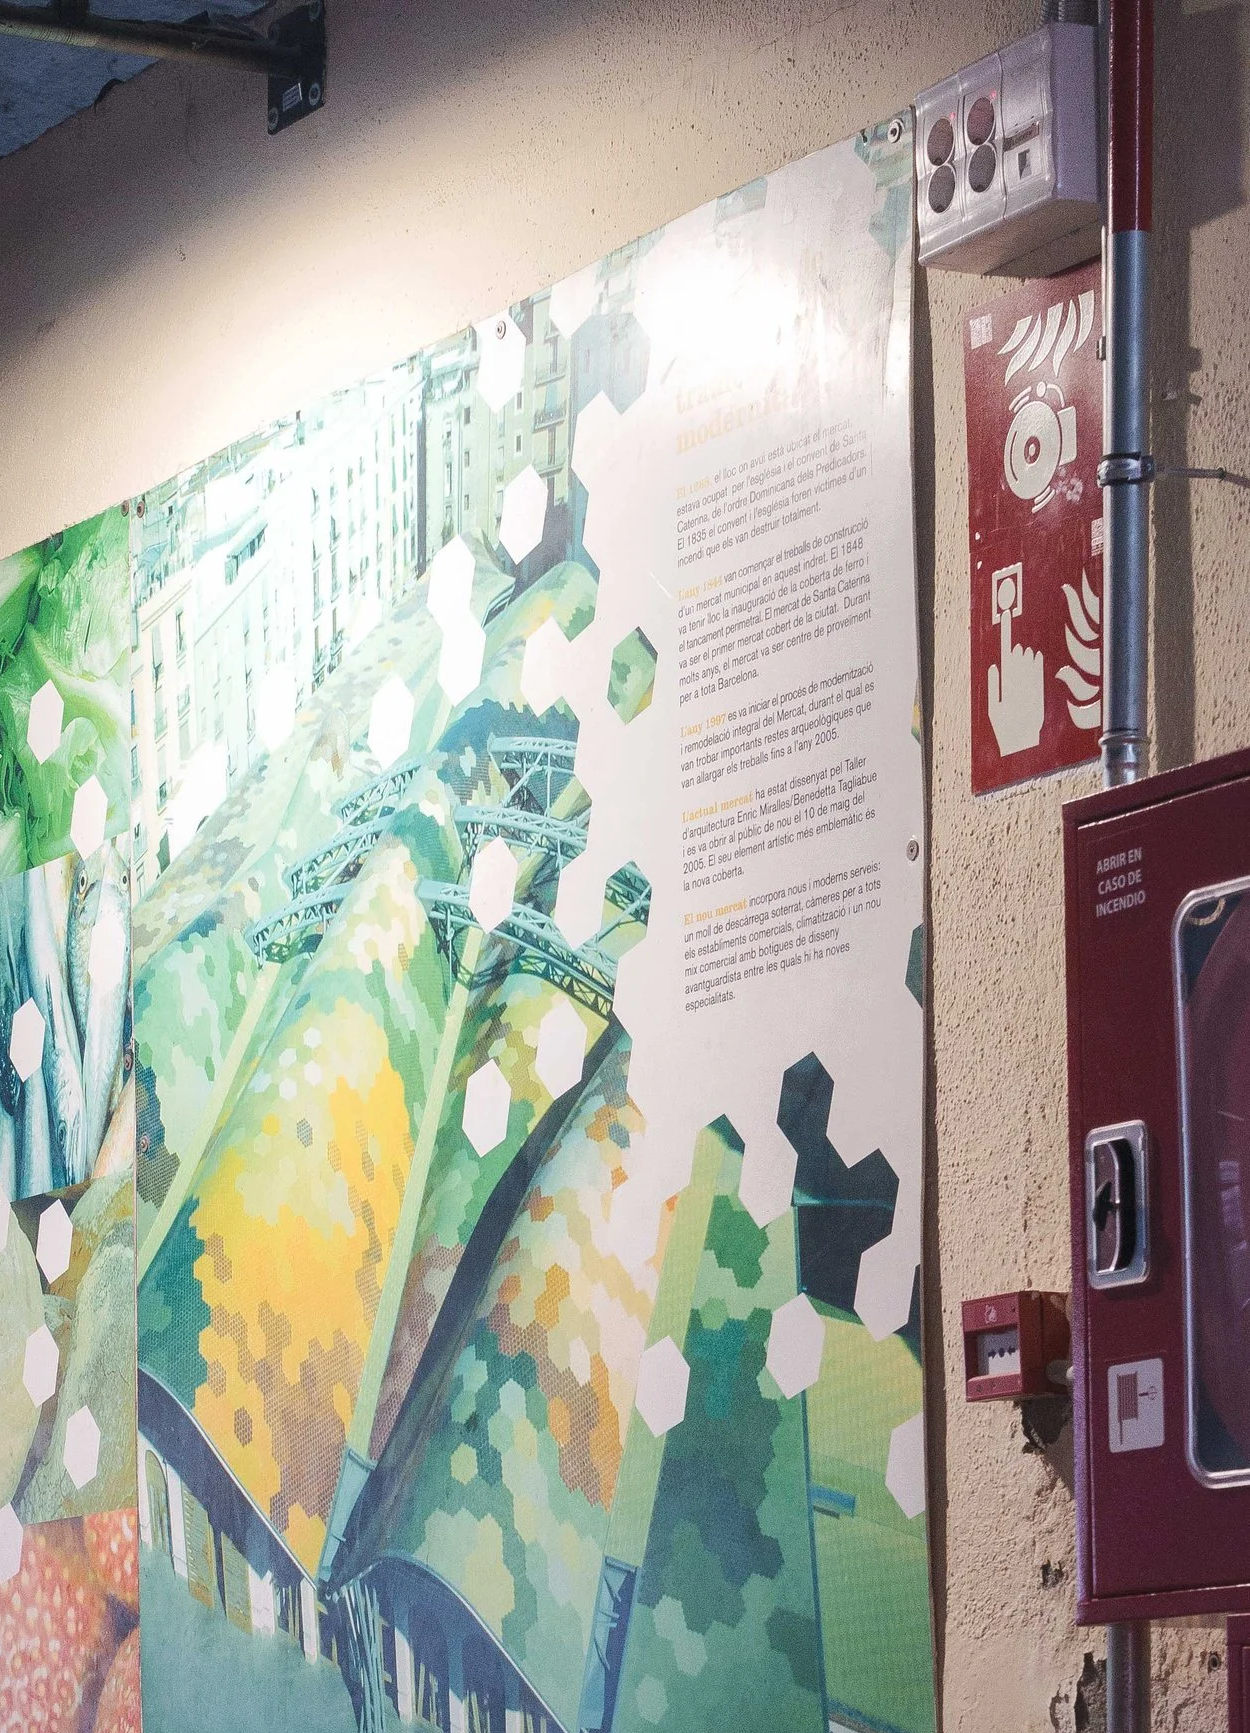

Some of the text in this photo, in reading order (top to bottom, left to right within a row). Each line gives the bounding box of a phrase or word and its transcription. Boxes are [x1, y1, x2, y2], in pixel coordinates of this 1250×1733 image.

[687, 529, 707, 545] 1835
[717, 512, 748, 533] convent
[791, 489, 812, 503] foren
[849, 467, 867, 480] d'un
[723, 497, 748, 513] l'ordre
[749, 478, 795, 502] Dominicana
[797, 469, 814, 483] dels
[816, 450, 868, 475] Predicadors.
[750, 517, 780, 537] destruir
[782, 501, 823, 525] totalment.
[738, 557, 774, 577] començar
[784, 541, 811, 559] treballs
[824, 518, 869, 544] construcció
[678, 538, 864, 617] d'un mercat municipal aquest indret. 1848
[689, 558, 865, 631] tenir inauguració coberta ferro
[686, 574, 871, 649] tancament perimetral. mercat Santa Caterina
[711, 642, 736, 660] primer
[737, 629, 764, 647] mercat
[766, 619, 791, 637] cobert
[843, 589, 871, 608] Durant
[679, 671, 700, 686] molts
[701, 666, 722, 678] anys,
[732, 648, 759, 666] mercat
[786, 632, 812, 647] centre
[701, 670, 760, 696] tota Barcelona.
[684, 729, 731, 753] remodelació
[733, 718, 761, 737] integral
[808, 693, 834, 711] durant
[845, 683, 863, 702] qual
[706, 713, 726, 728] 1997
[749, 699, 770, 714] iniciar
[820, 661, 874, 688] modernització
[696, 708, 854, 767] trobar importants restes arqueològiques
[696, 728, 841, 783] allargar treballs fins l'any 2005.
[683, 773, 878, 840] d'arquitectura Enric Miralles/Benedetta Tagliabue
[721, 791, 754, 810] mercat
[767, 780, 788, 795] estat
[789, 767, 828, 788] dissenyat
[846, 757, 867, 770] Taller
[709, 798, 850, 849] obrir públic maig
[683, 859, 707, 874] 2005.
[734, 840, 766, 858] element
[692, 866, 746, 888] nova coberta.
[1096, 847, 1142, 875] ABRIR EN
[1098, 869, 1142, 895] CASO DE
[715, 861, 882, 915] mercat incorpora moderns serveis:
[1096, 890, 1146, 917] INCENDIO
[695, 925, 712, 939] moll
[698, 934, 747, 955] establiments
[796, 905, 847, 928] climatització
[699, 928, 840, 972] comercial botigues disseny
[685, 943, 850, 993] avantguardista entre quals noves
[686, 990, 737, 1011] especialitats.
